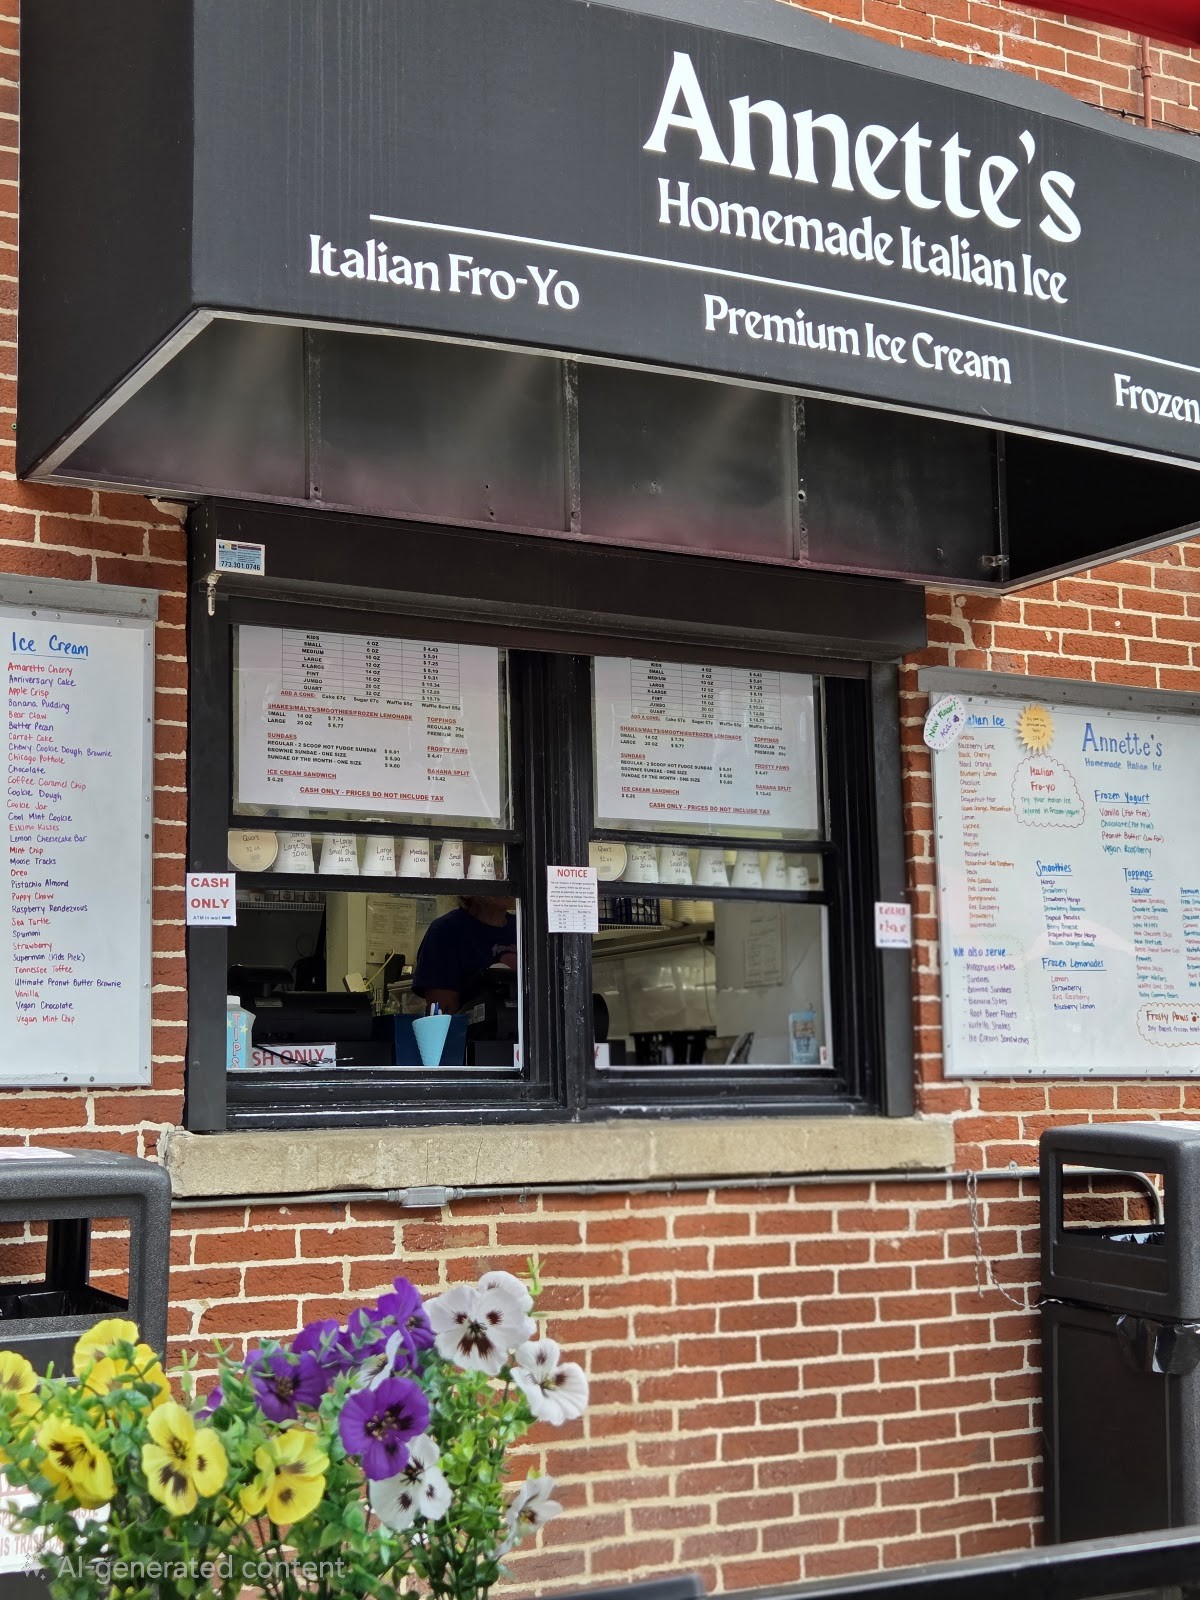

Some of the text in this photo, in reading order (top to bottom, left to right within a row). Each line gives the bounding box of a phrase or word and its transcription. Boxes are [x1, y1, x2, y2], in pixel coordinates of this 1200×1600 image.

[642, 50, 1083, 244] Annette's
[657, 177, 1070, 305] Homemade Italian Ice
[308, 234, 581, 310] Italian Fro-Yo
[703, 292, 1013, 385] Premium Ice Cream
[1113, 372, 1200, 425] Frozen
[12, 631, 89, 656] Ice Cream
[8, 662, 73, 677] Amaretto Cherry
[9, 675, 76, 687] Anniversary Cake
[8, 687, 49, 698] Apple Crisp
[8, 699, 70, 714] Banana Pudding
[9, 711, 26, 719] Bear
[966, 714, 1005, 727] alian Ice
[8, 721, 54, 731] Butter Pecan
[36, 735, 54, 743] Cake
[1082, 722, 1163, 757] Annette's
[36, 744, 58, 752] Cookie
[61, 746, 83, 757] Dough
[8, 752, 65, 765] Chicago Pothole
[1085, 757, 1162, 771] Homemade Italian Ice
[8, 764, 45, 774] Chocolate
[7, 776, 86, 791] Coffee Caramel Chip
[7, 787, 62, 802] Cookie Dough
[346, 789, 371, 797] PRICES
[1094, 789, 1150, 805] Frozen Yogurt
[6, 799, 48, 811] Cookie Jar
[8, 812, 73, 822] Cool Mint Cookie
[9, 823, 60, 832] Eskimo Kisses
[9, 835, 32, 843] Lemon
[73, 834, 88, 842] Bar
[9, 846, 44, 856] Mint Chip
[9, 857, 57, 866] Moose Tracks
[10, 868, 28, 877] Oreo
[557, 869, 588, 878] NOTICE
[1036, 860, 1072, 876] Smoothies
[1122, 868, 1153, 882] Toppings
[11, 879, 69, 889] Pistachio Almond
[191, 877, 229, 888] CASH
[11, 892, 55, 902] Puppy Chow
[191, 898, 230, 909] ONLY
[11, 904, 88, 915] Raspberry Rendezvous
[11, 917, 51, 927] Sea Turtle
[12, 930, 41, 939] Spumoni
[12, 942, 53, 952] Strawberry
[13, 953, 46, 963] Superman
[1041, 957, 1067, 969] Frozen
[14, 964, 74, 974] Tennessee Toffee
[14, 977, 122, 988] Ultimate Peanut Butter Brownie
[14, 989, 40, 998] Vanilla
[15, 1000, 74, 1012] Vegan Chocolate
[16, 1014, 76, 1026] Vegan Mint Chip
[230, 1012, 241, 1068] TIPS
[251, 1048, 325, 1067] SH ONLY
